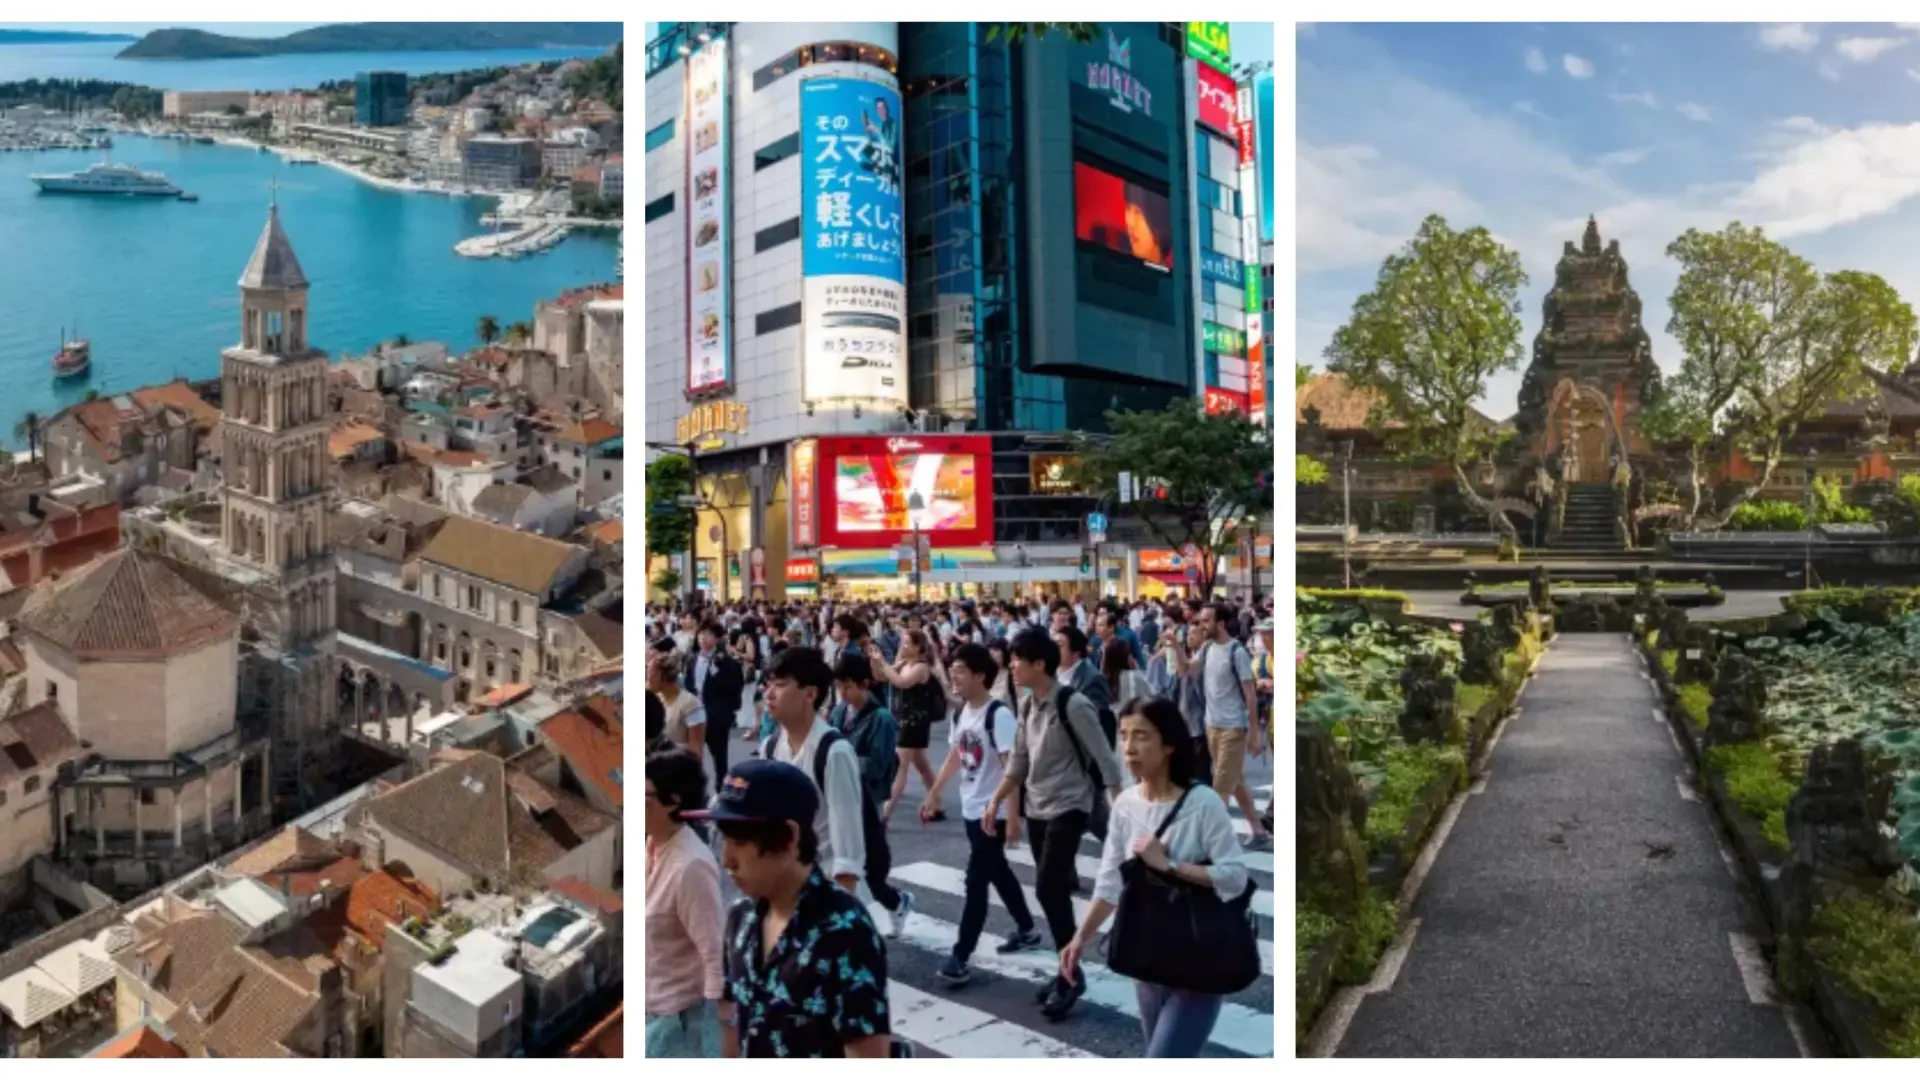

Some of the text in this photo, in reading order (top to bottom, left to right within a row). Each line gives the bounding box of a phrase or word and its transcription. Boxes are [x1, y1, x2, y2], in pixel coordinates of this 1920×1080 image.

[815, 115, 848, 131] その
[815, 191, 901, 235] 軽くして
